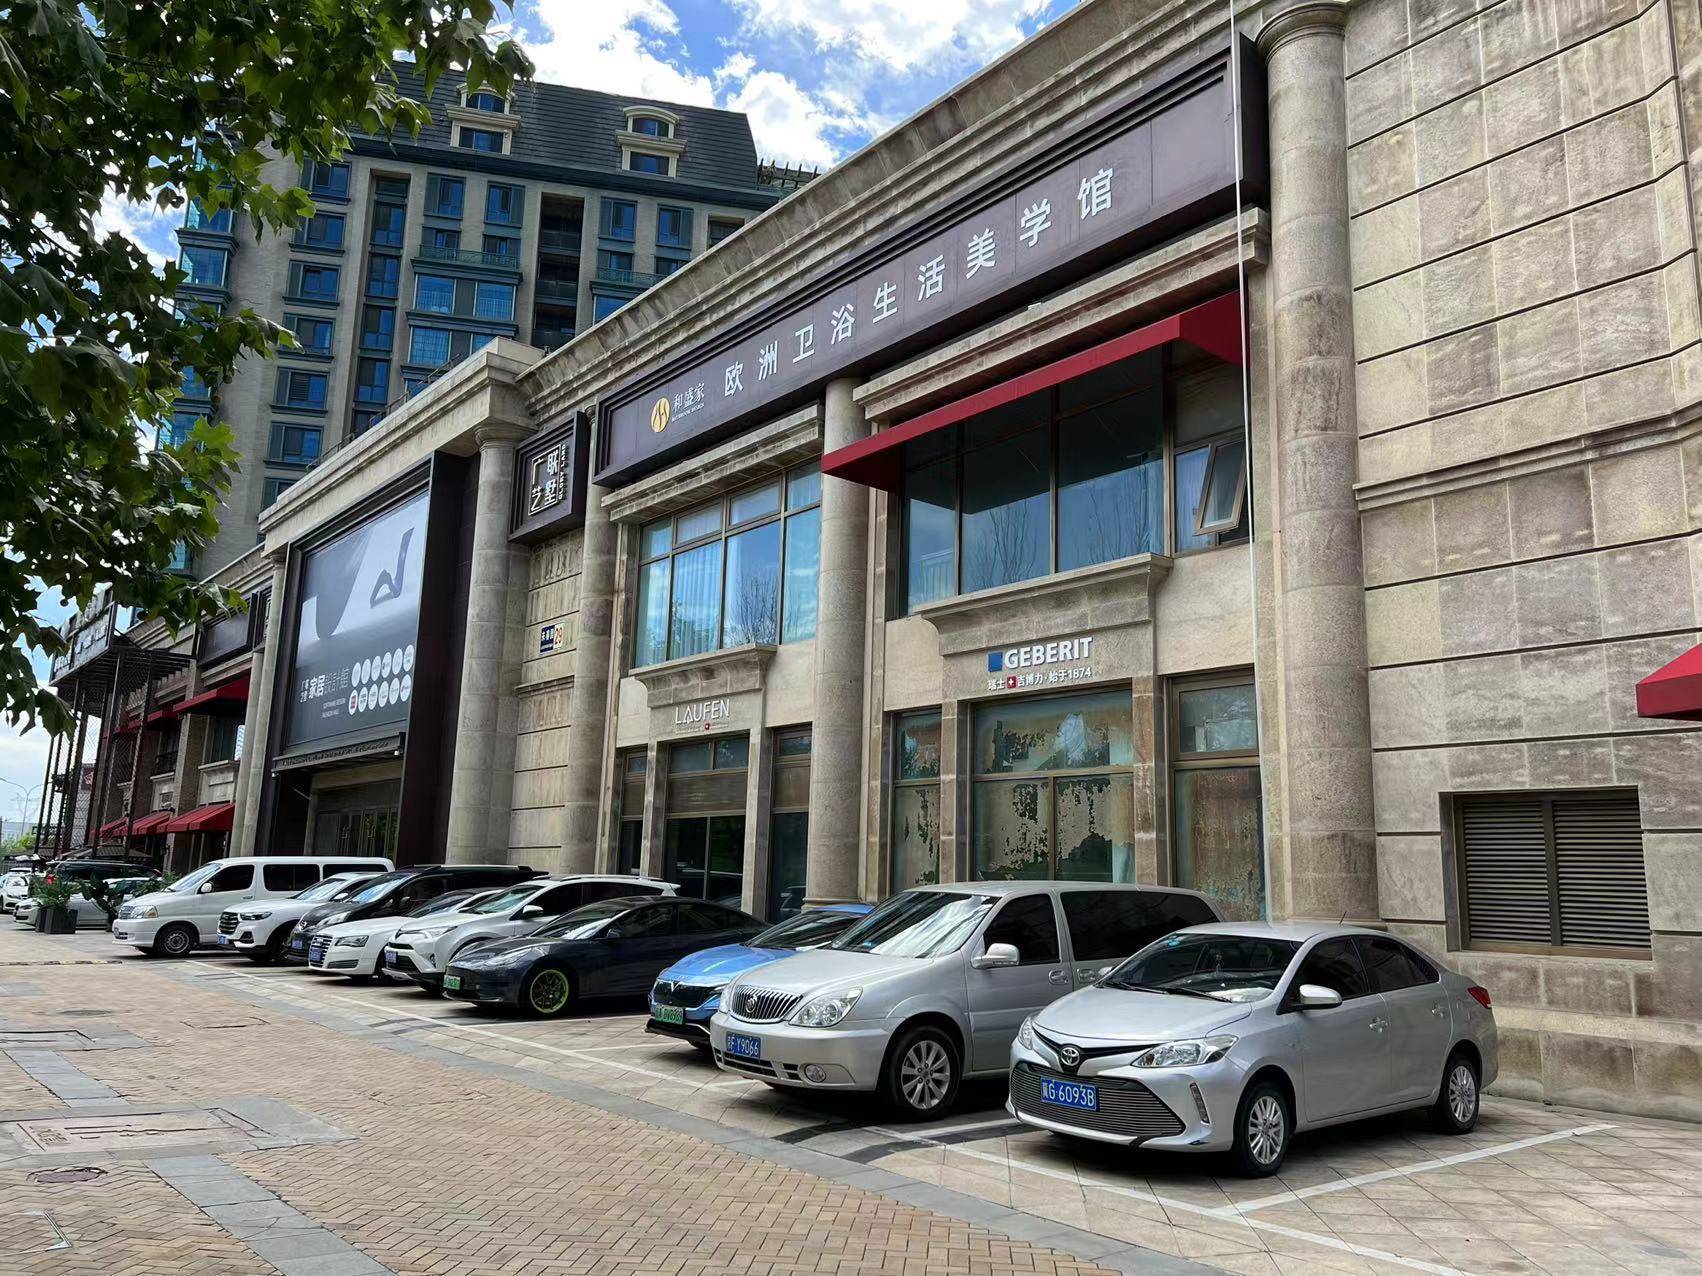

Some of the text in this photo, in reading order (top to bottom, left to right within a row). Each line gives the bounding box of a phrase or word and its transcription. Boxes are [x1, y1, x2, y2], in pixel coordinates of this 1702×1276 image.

[724, 167, 1115, 397] 欧洲卫浴生活美学馆
[1004, 636, 1093, 669] GEBERIT
[674, 698, 731, 725] LAUFEN
